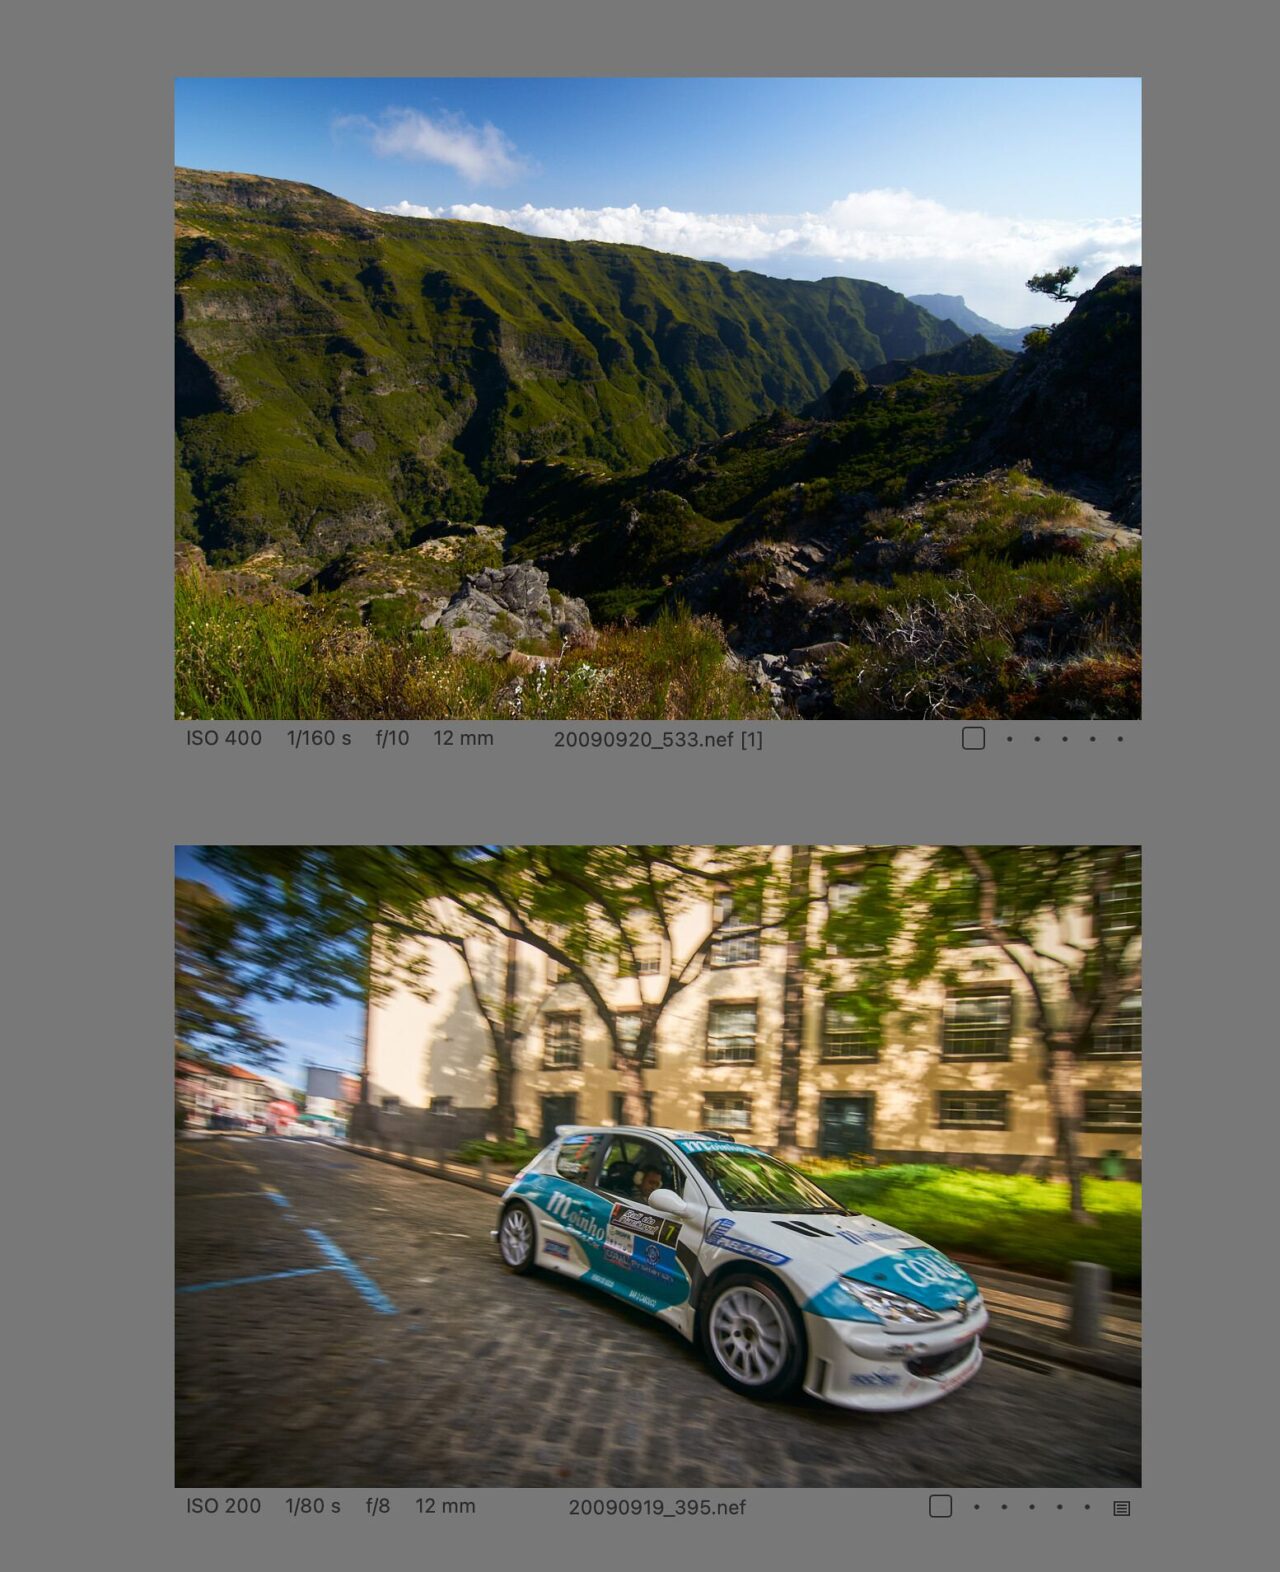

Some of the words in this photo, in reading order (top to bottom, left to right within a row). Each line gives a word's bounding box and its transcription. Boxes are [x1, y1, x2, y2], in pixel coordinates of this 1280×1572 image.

[187, 729, 219, 746] ISO
[224, 729, 262, 746] 400
[287, 729, 336, 750] 1/160
[341, 733, 352, 746] s
[375, 729, 410, 750] f/10
[433, 729, 454, 746] 12
[460, 733, 494, 746] mm
[554, 730, 735, 750] 20090920_533.nef
[741, 730, 763, 751] [1]
[187, 1497, 219, 1514] ISO
[224, 1497, 262, 1514] 200
[285, 1497, 325, 1517] 1/80
[331, 1501, 341, 1514] s
[365, 1497, 391, 1517] f/8
[415, 1497, 436, 1514] 12
[442, 1501, 476, 1514] mm
[569, 1498, 747, 1518] 20090919_395.nef
